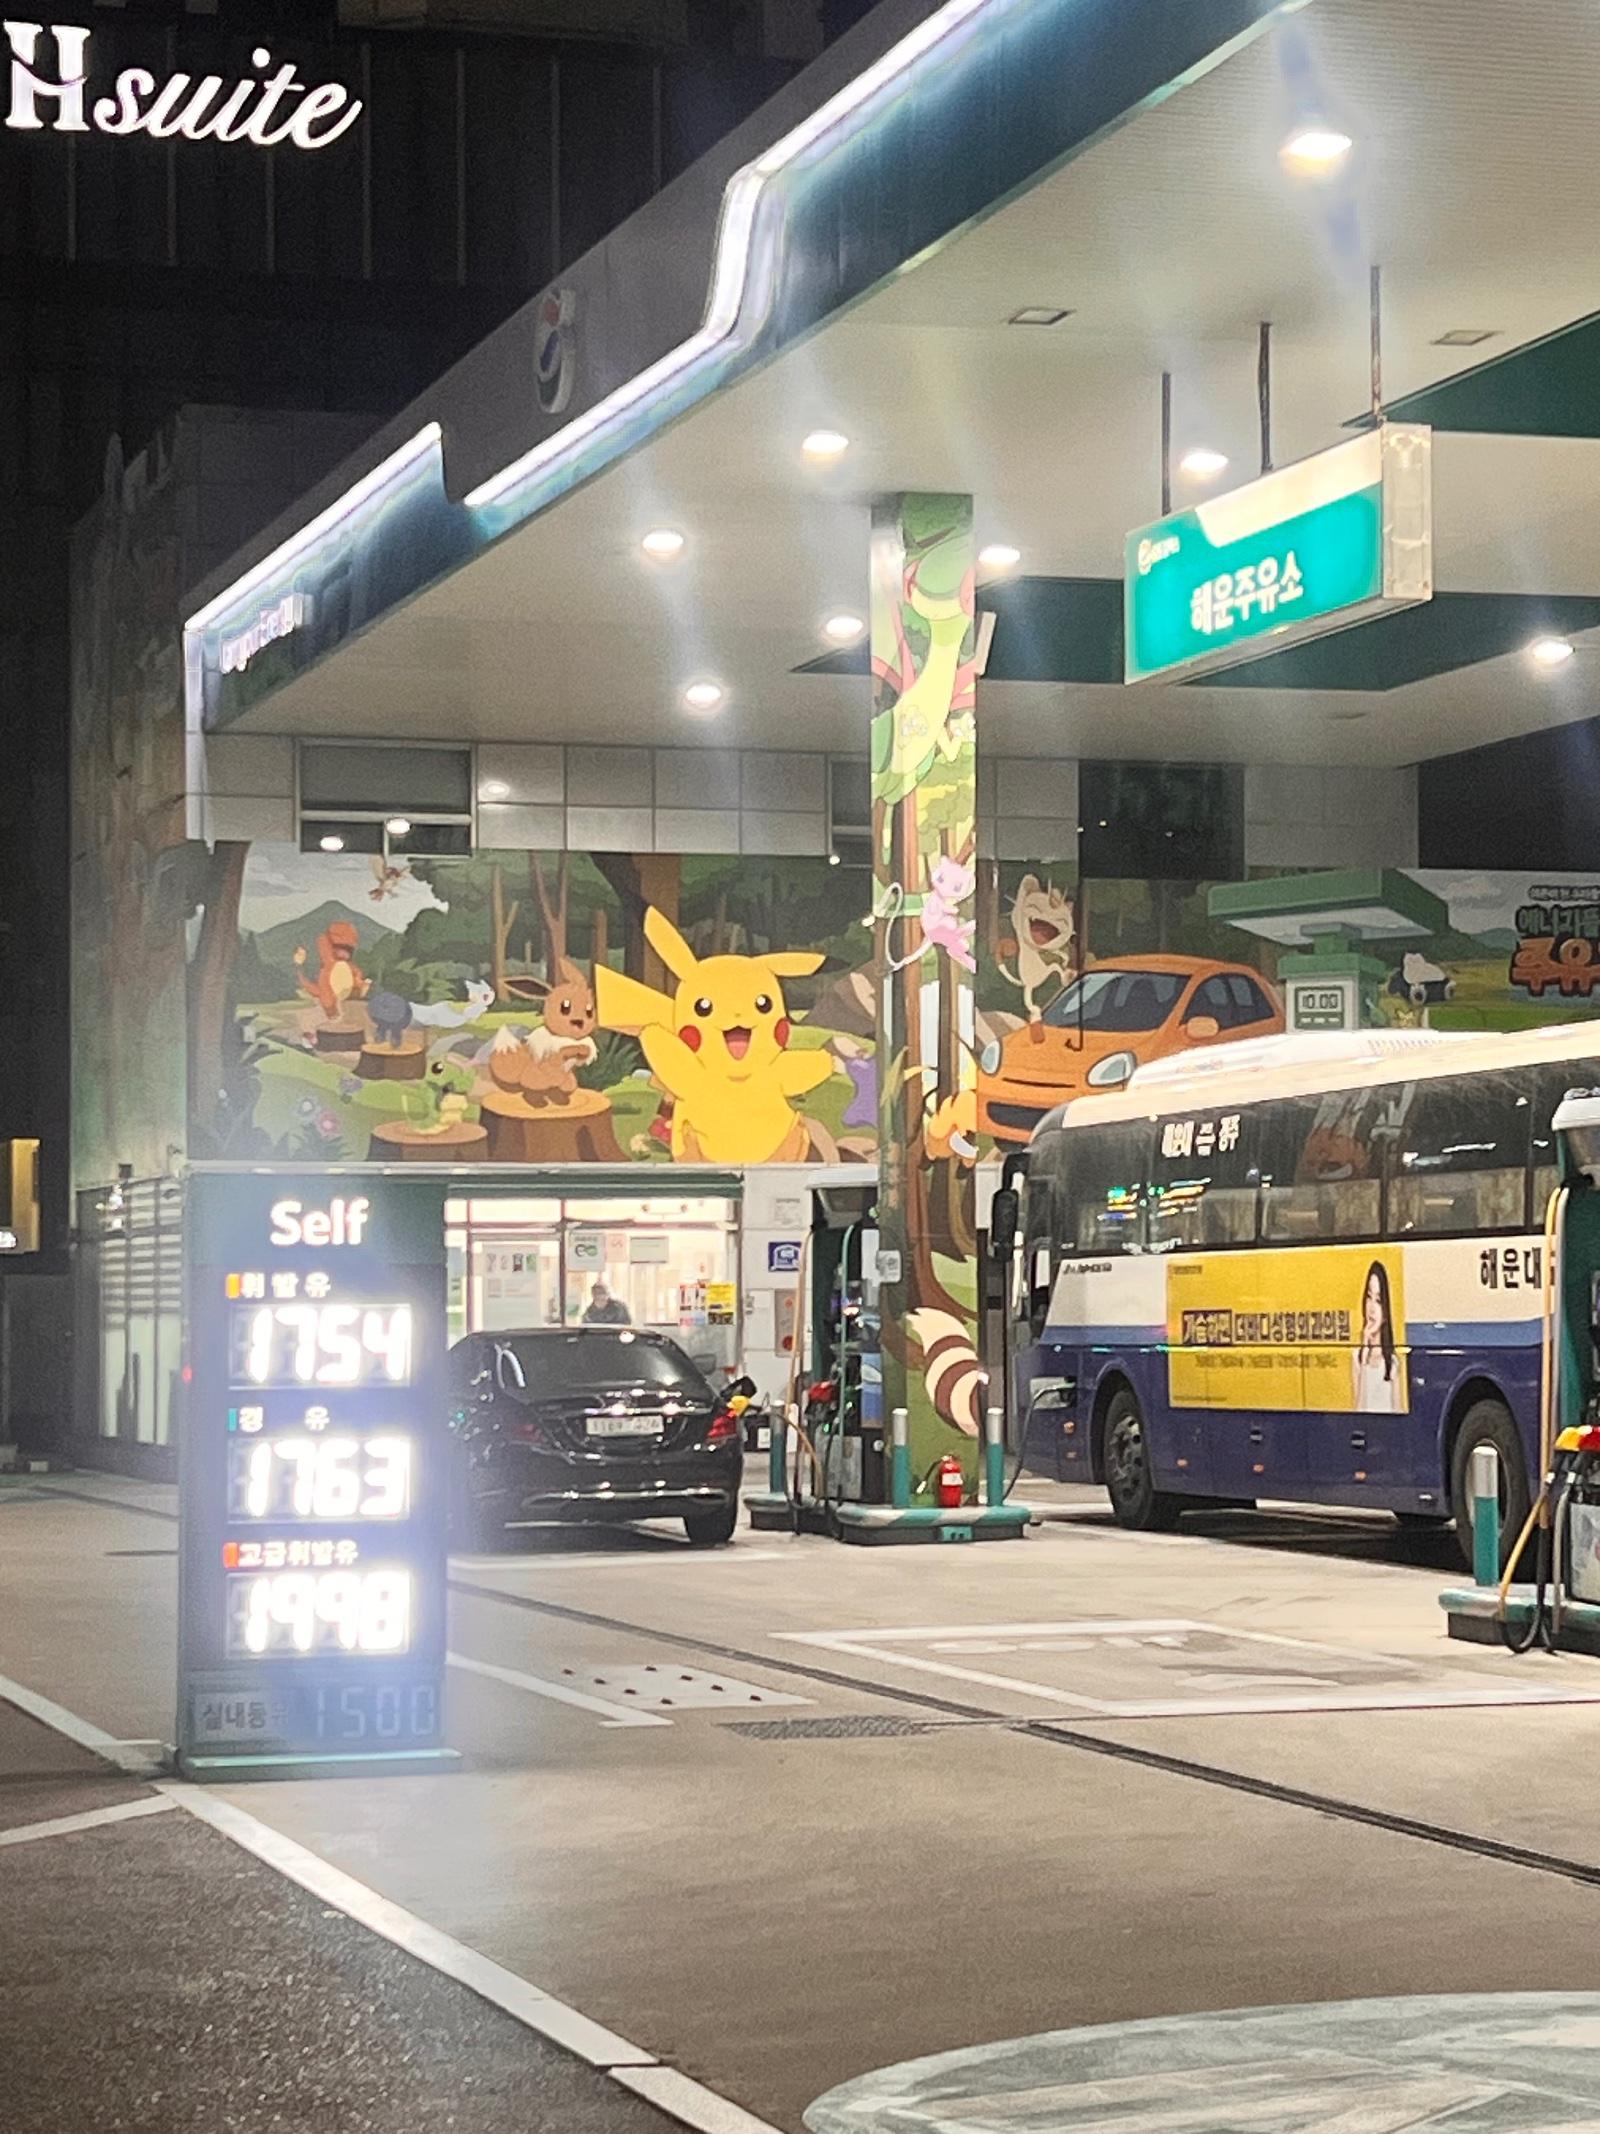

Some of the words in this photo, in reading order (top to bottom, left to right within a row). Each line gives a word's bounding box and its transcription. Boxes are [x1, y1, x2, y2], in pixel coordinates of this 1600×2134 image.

[1190, 550, 1304, 635] 해운주유소
[1512, 937, 1600, 996] 주유
[269, 1197, 370, 1246] Self
[241, 1272, 331, 1298] 휘발유
[1480, 1247, 1556, 1289] 해운대
[248, 1304, 411, 1382] 1754
[247, 1438, 410, 1517] 1763
[239, 1540, 358, 1567] 고급휘발유
[245, 1570, 410, 1653] 1998
[316, 1685, 436, 1738] 1500
